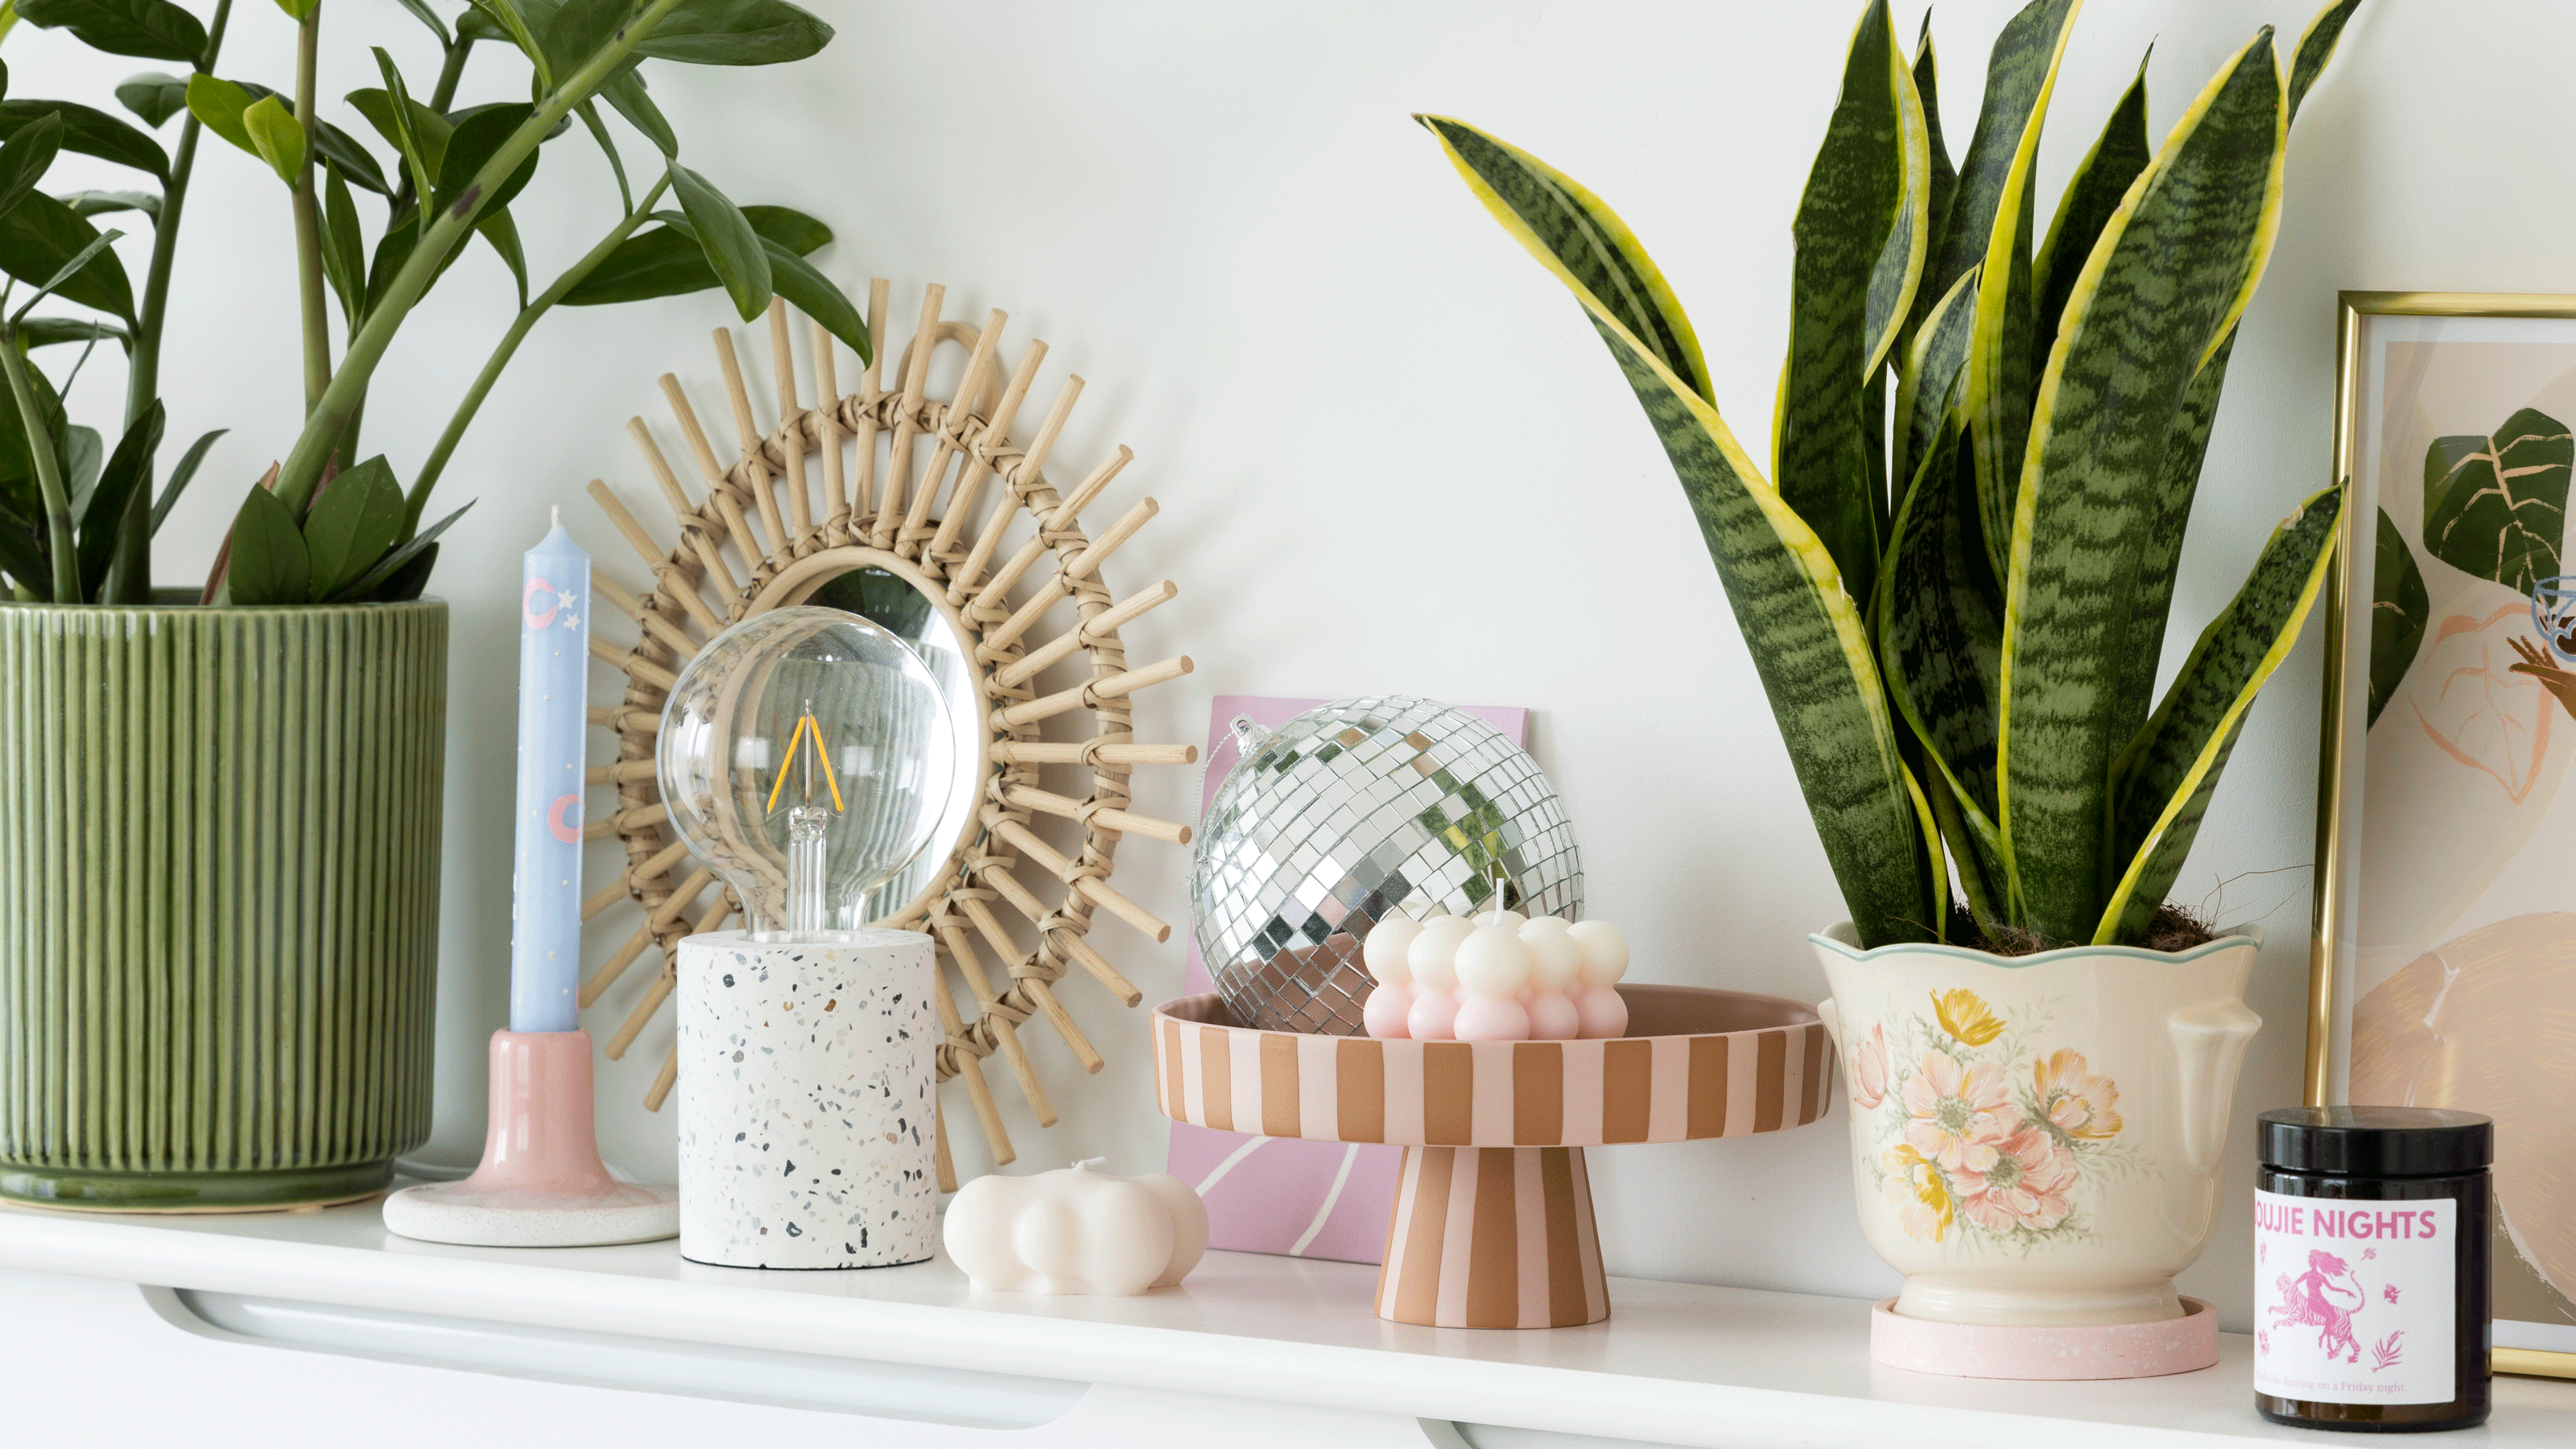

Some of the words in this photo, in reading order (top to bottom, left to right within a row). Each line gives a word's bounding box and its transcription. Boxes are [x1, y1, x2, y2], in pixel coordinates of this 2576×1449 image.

[2254, 1199, 2303, 1236] OUJIE
[2314, 1209, 2436, 1240] NIGHTS
[2283, 1376, 2315, 1391] dancing
[2317, 1382, 2330, 1390] on
[2332, 1382, 2339, 1391] a
[2341, 1381, 2374, 1394] Friday
[2376, 1381, 2406, 1395] night.
